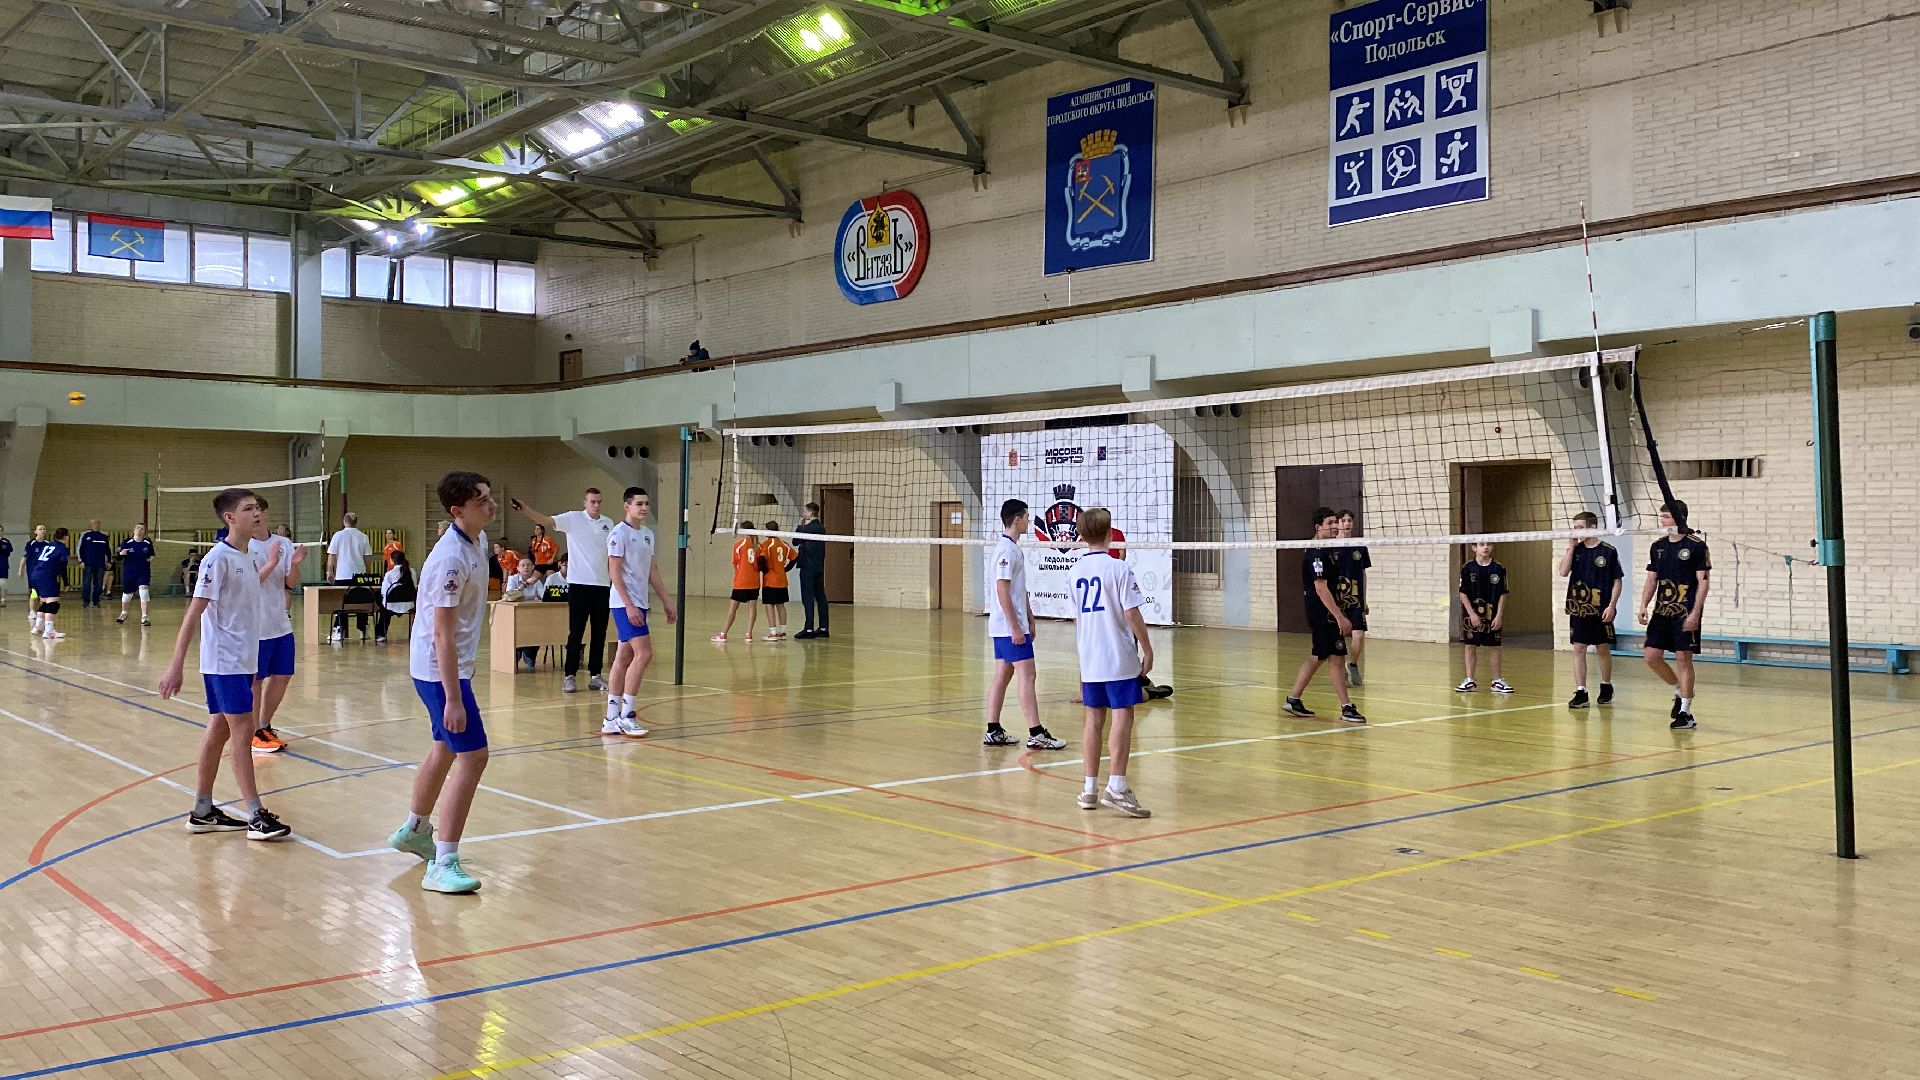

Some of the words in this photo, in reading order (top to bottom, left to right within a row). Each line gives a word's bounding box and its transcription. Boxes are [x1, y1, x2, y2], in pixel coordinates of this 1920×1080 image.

[1330, 0, 1483, 43] «Спорт-Сервис
[1365, 29, 1446, 64] Подольск
[1070, 82, 1131, 108] АДМИНИСТРАЦИИ
[1047, 107, 1089, 126] ГОРОДСКОГО
[1089, 101, 1116, 116] ОКРУГА
[776, 546, 784, 562] 3
[1076, 576, 1105, 613] 22
